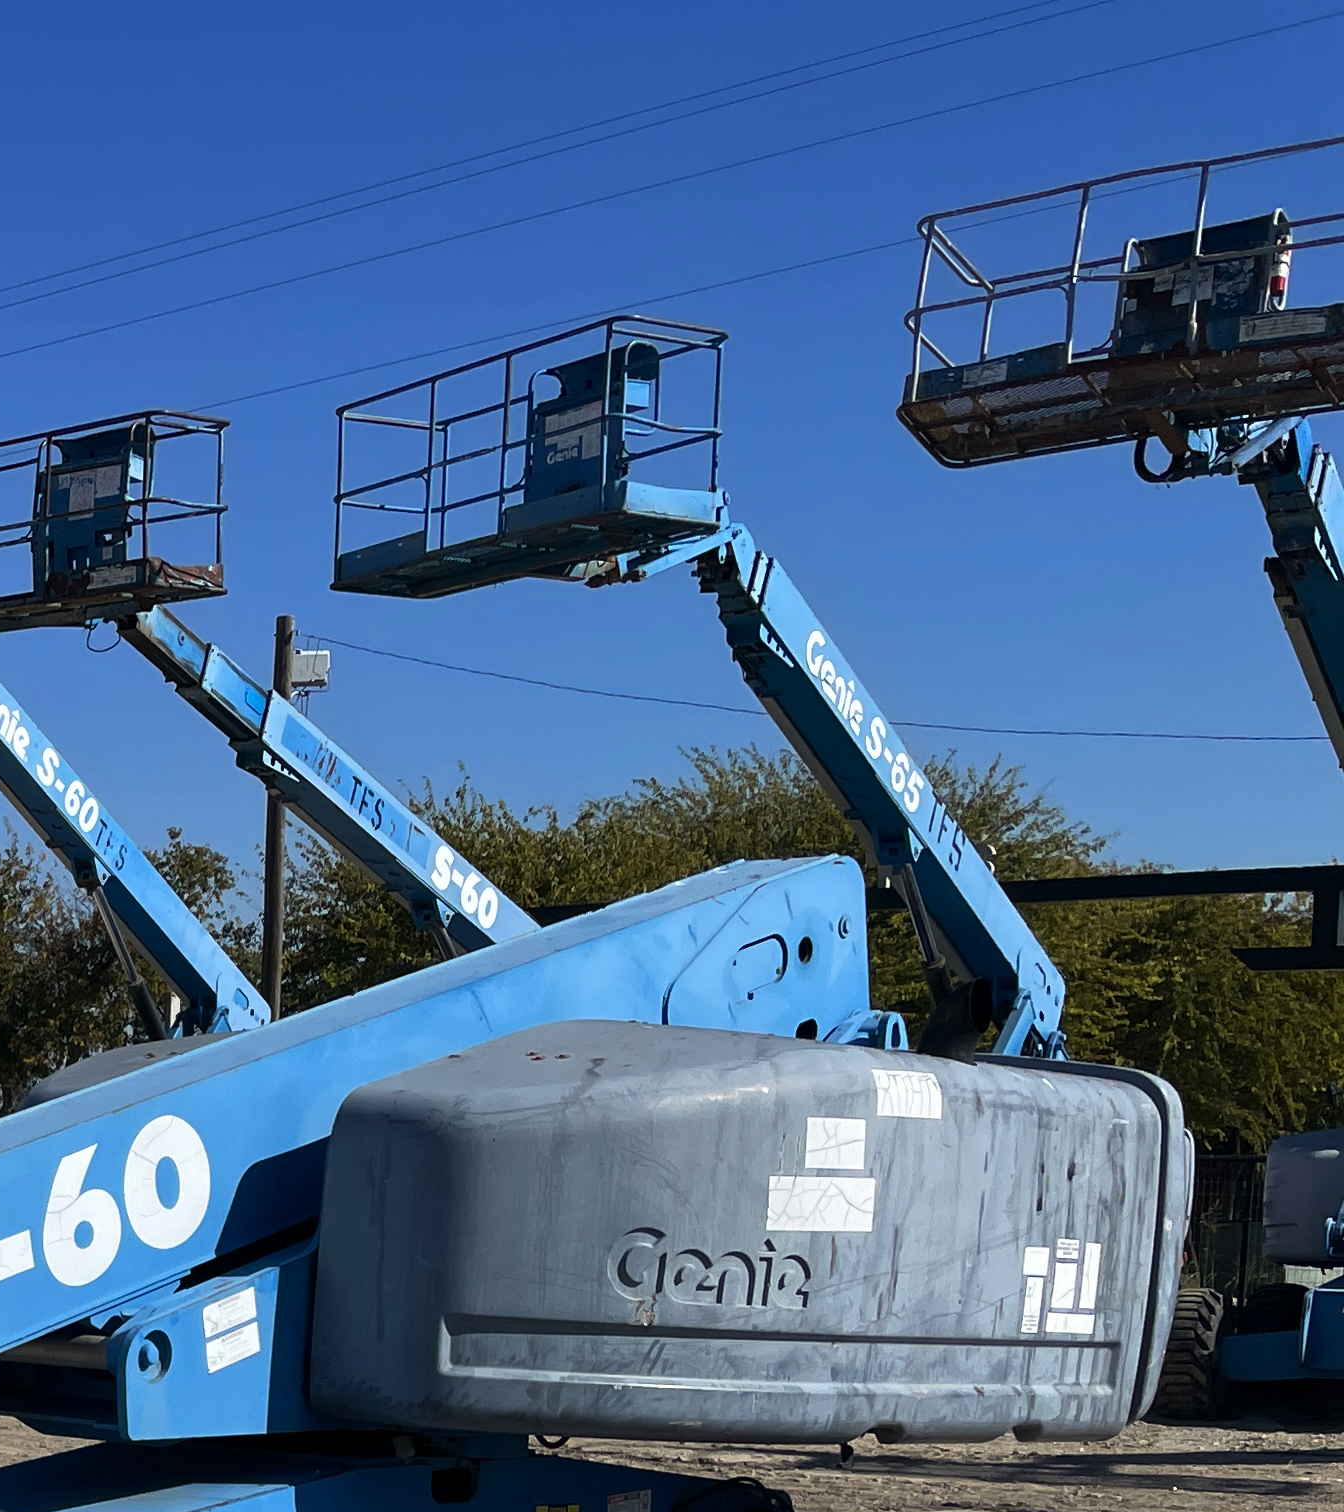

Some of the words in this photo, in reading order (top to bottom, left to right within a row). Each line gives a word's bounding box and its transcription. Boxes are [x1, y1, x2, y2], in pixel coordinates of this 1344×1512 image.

[36, 747, 99, 833] S-60
[806, 630, 864, 736] Genie
[865, 716, 924, 813] S-65
[928, 790, 966, 872] TFS
[349, 775, 386, 831] TFS
[430, 845, 499, 929] S-60
[607, 1226, 812, 1309] Genie
